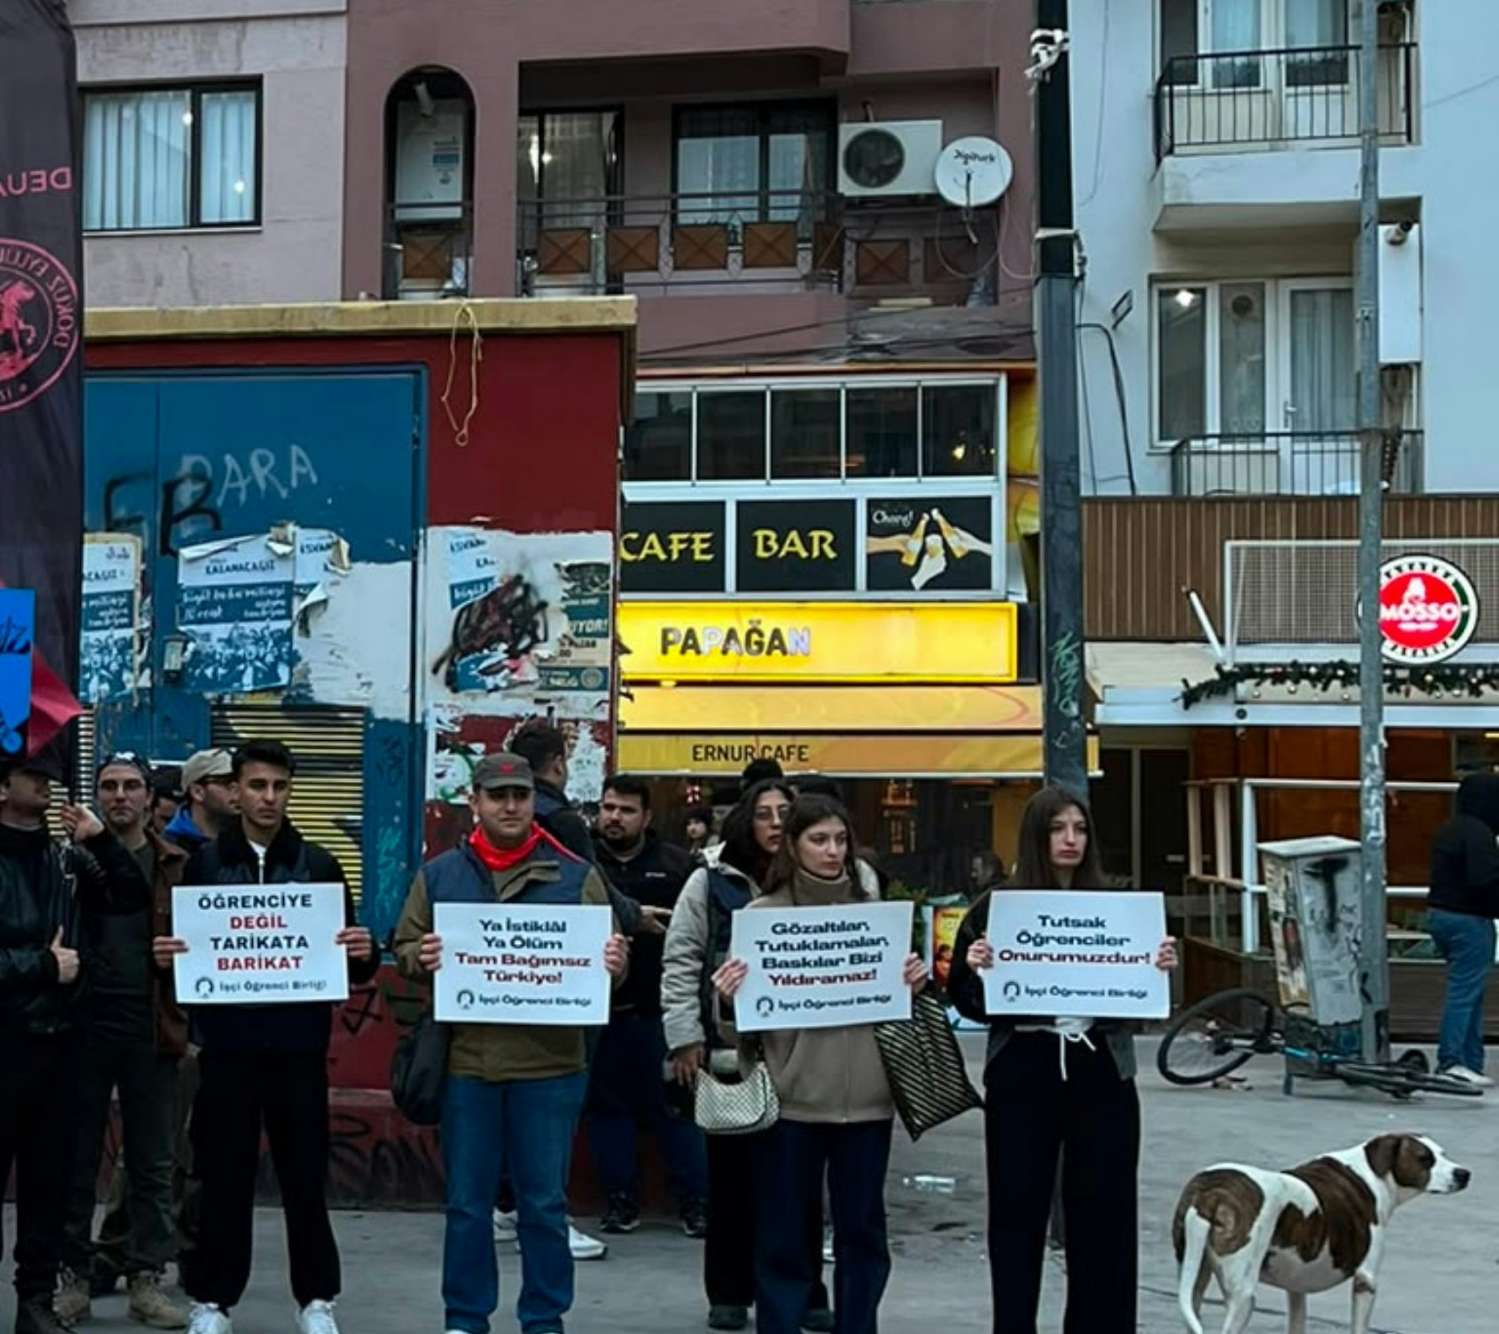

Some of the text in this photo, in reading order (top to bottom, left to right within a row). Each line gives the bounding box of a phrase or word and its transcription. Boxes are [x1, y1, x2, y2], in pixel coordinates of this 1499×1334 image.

[620, 528, 838, 562] CAFE BAR
[660, 618, 812, 657] PAPAĞAN
[692, 745, 810, 763] ERNUR CAFE
[198, 892, 312, 910] ÖĞRENCİYE
[230, 912, 288, 930] DEĞİL
[479, 919, 503, 932] Ya
[771, 920, 871, 935] Gözaltılar,
[1038, 914, 1107, 929] Tutsak
[210, 933, 309, 951] TARİKATA
[483, 935, 563, 950] Ya Ölüm
[755, 935, 890, 953] Tutuklamalar,
[1016, 930, 1132, 947] Öğrenciler
[217, 954, 303, 971] BARİKAT
[455, 952, 592, 968] Tam Bağımsız
[762, 951, 883, 970] Baskılar Bizi
[999, 949, 1151, 964] Onurumuzdur!
[484, 969, 563, 985] Türkiye!
[768, 969, 878, 987] Yıldıramaz!
